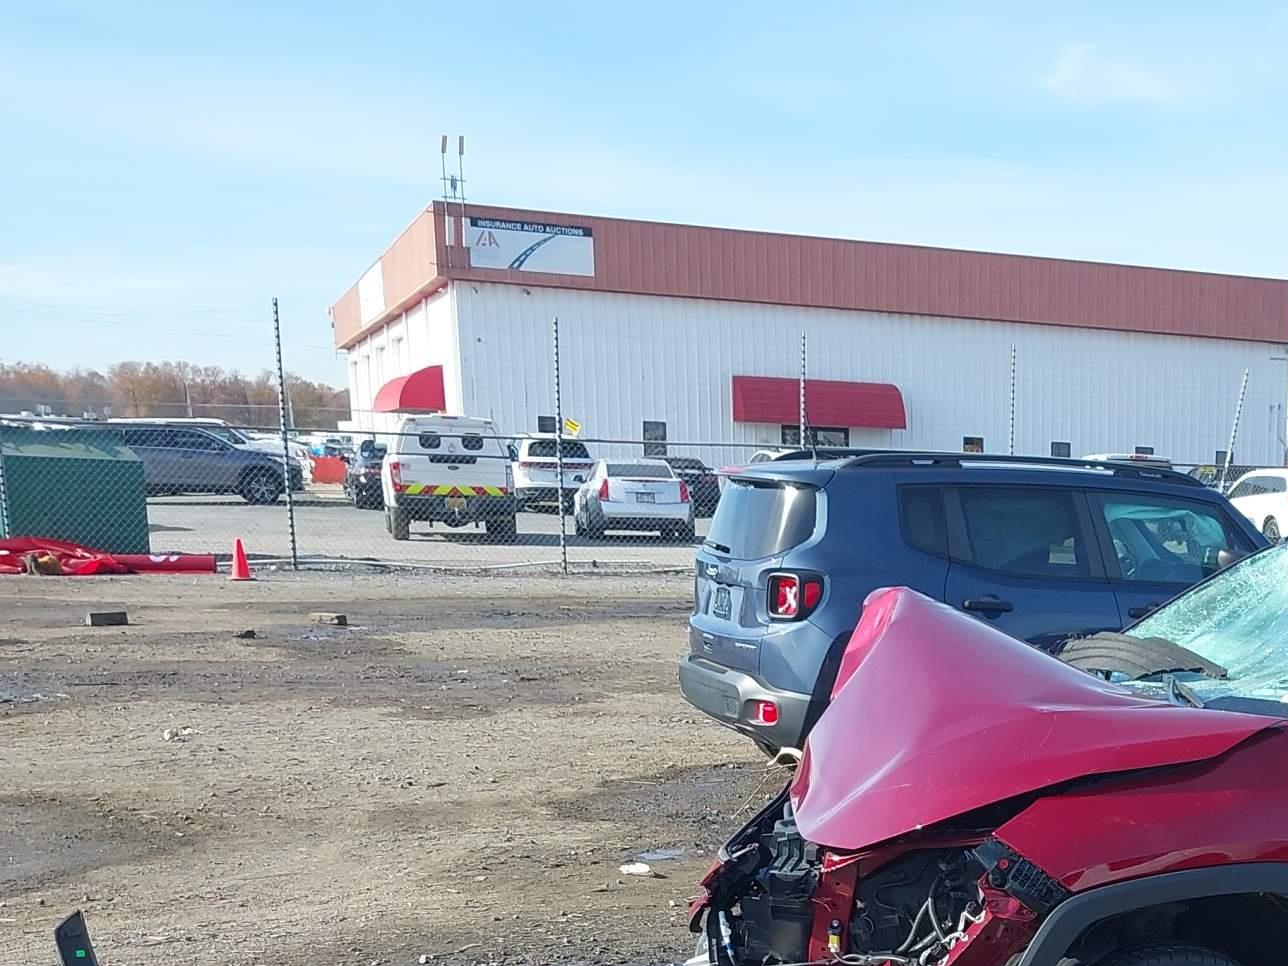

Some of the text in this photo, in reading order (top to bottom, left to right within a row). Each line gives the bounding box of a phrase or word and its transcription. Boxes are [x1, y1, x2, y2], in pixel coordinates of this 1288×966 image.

[477, 219, 584, 236] INSURANCE AUTO AUCTIONS
